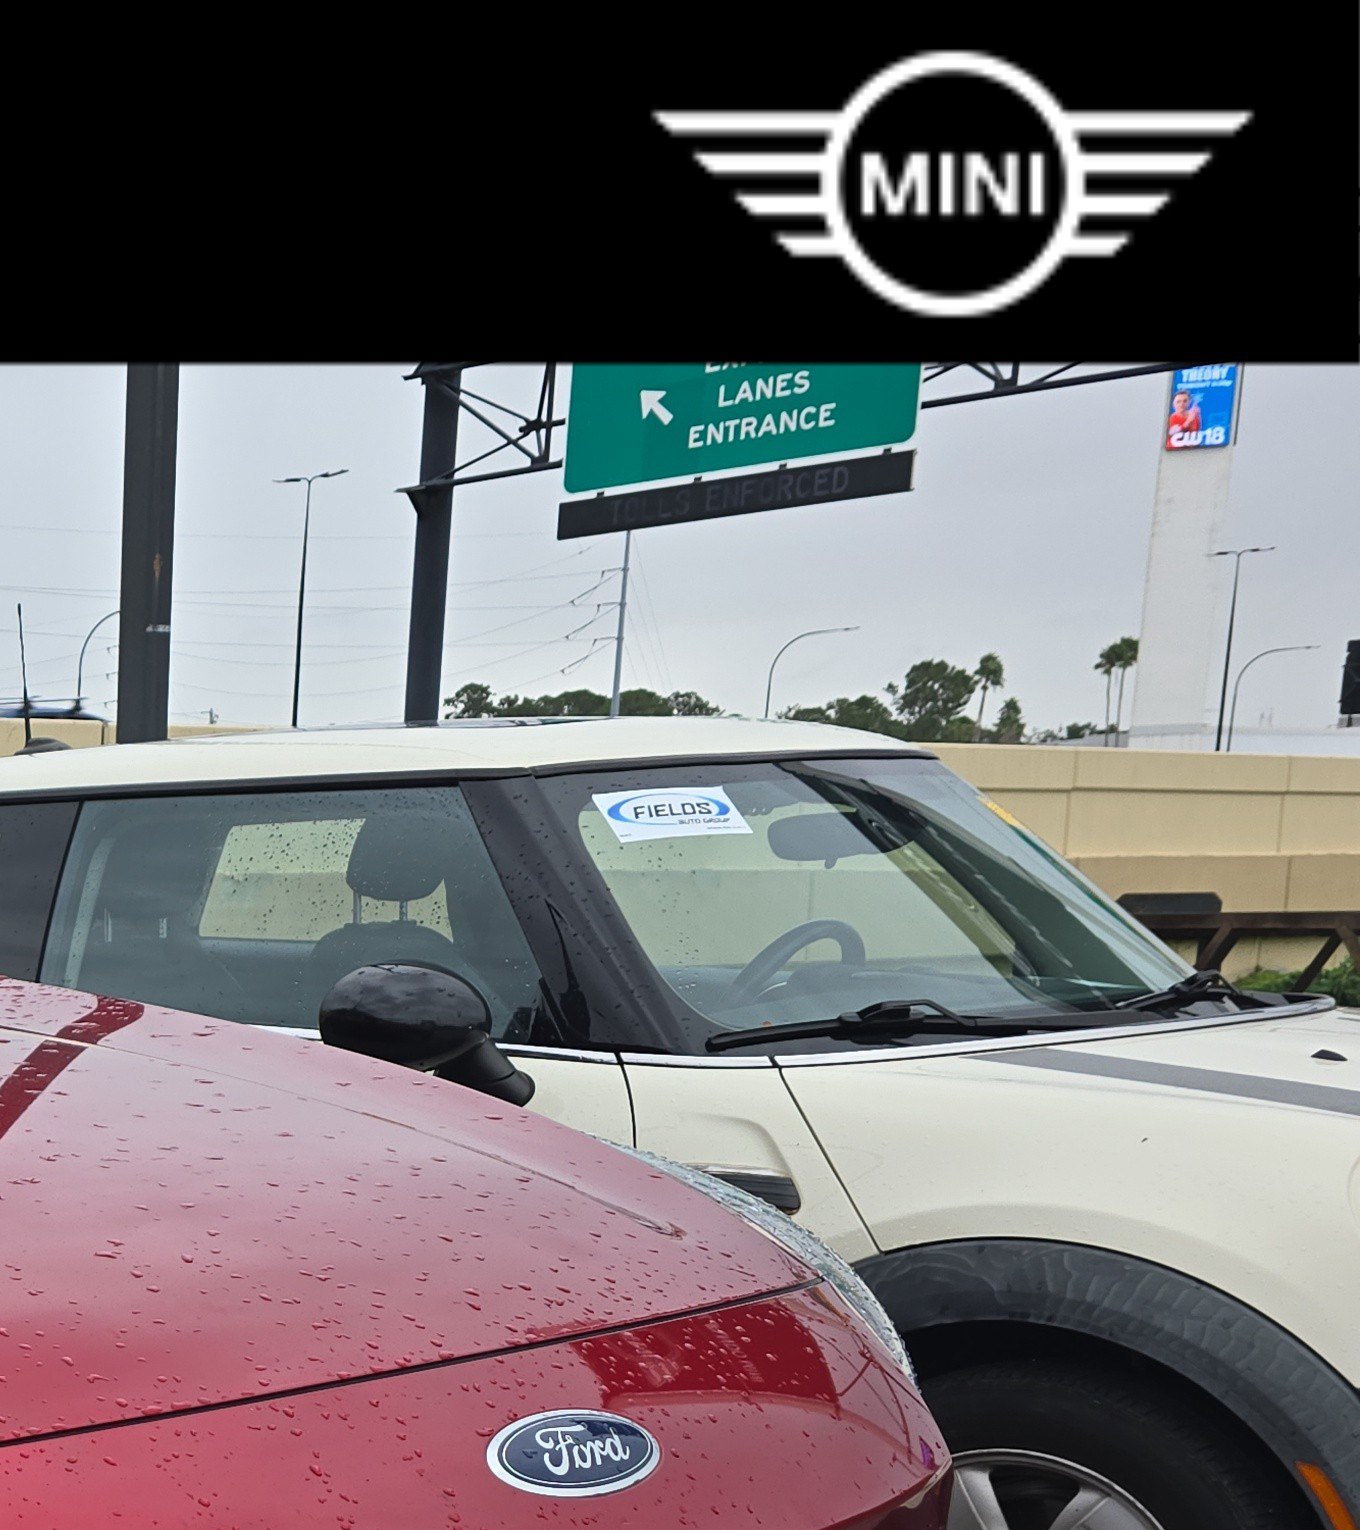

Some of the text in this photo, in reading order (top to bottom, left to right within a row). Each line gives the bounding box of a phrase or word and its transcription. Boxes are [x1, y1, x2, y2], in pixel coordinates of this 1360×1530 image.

[717, 370, 811, 408] LANES
[687, 402, 837, 449] ENTRANCE
[611, 465, 850, 526] TOLLS ENFORCED
[633, 802, 712, 820] FIELDS
[535, 1422, 630, 1475] Ford
